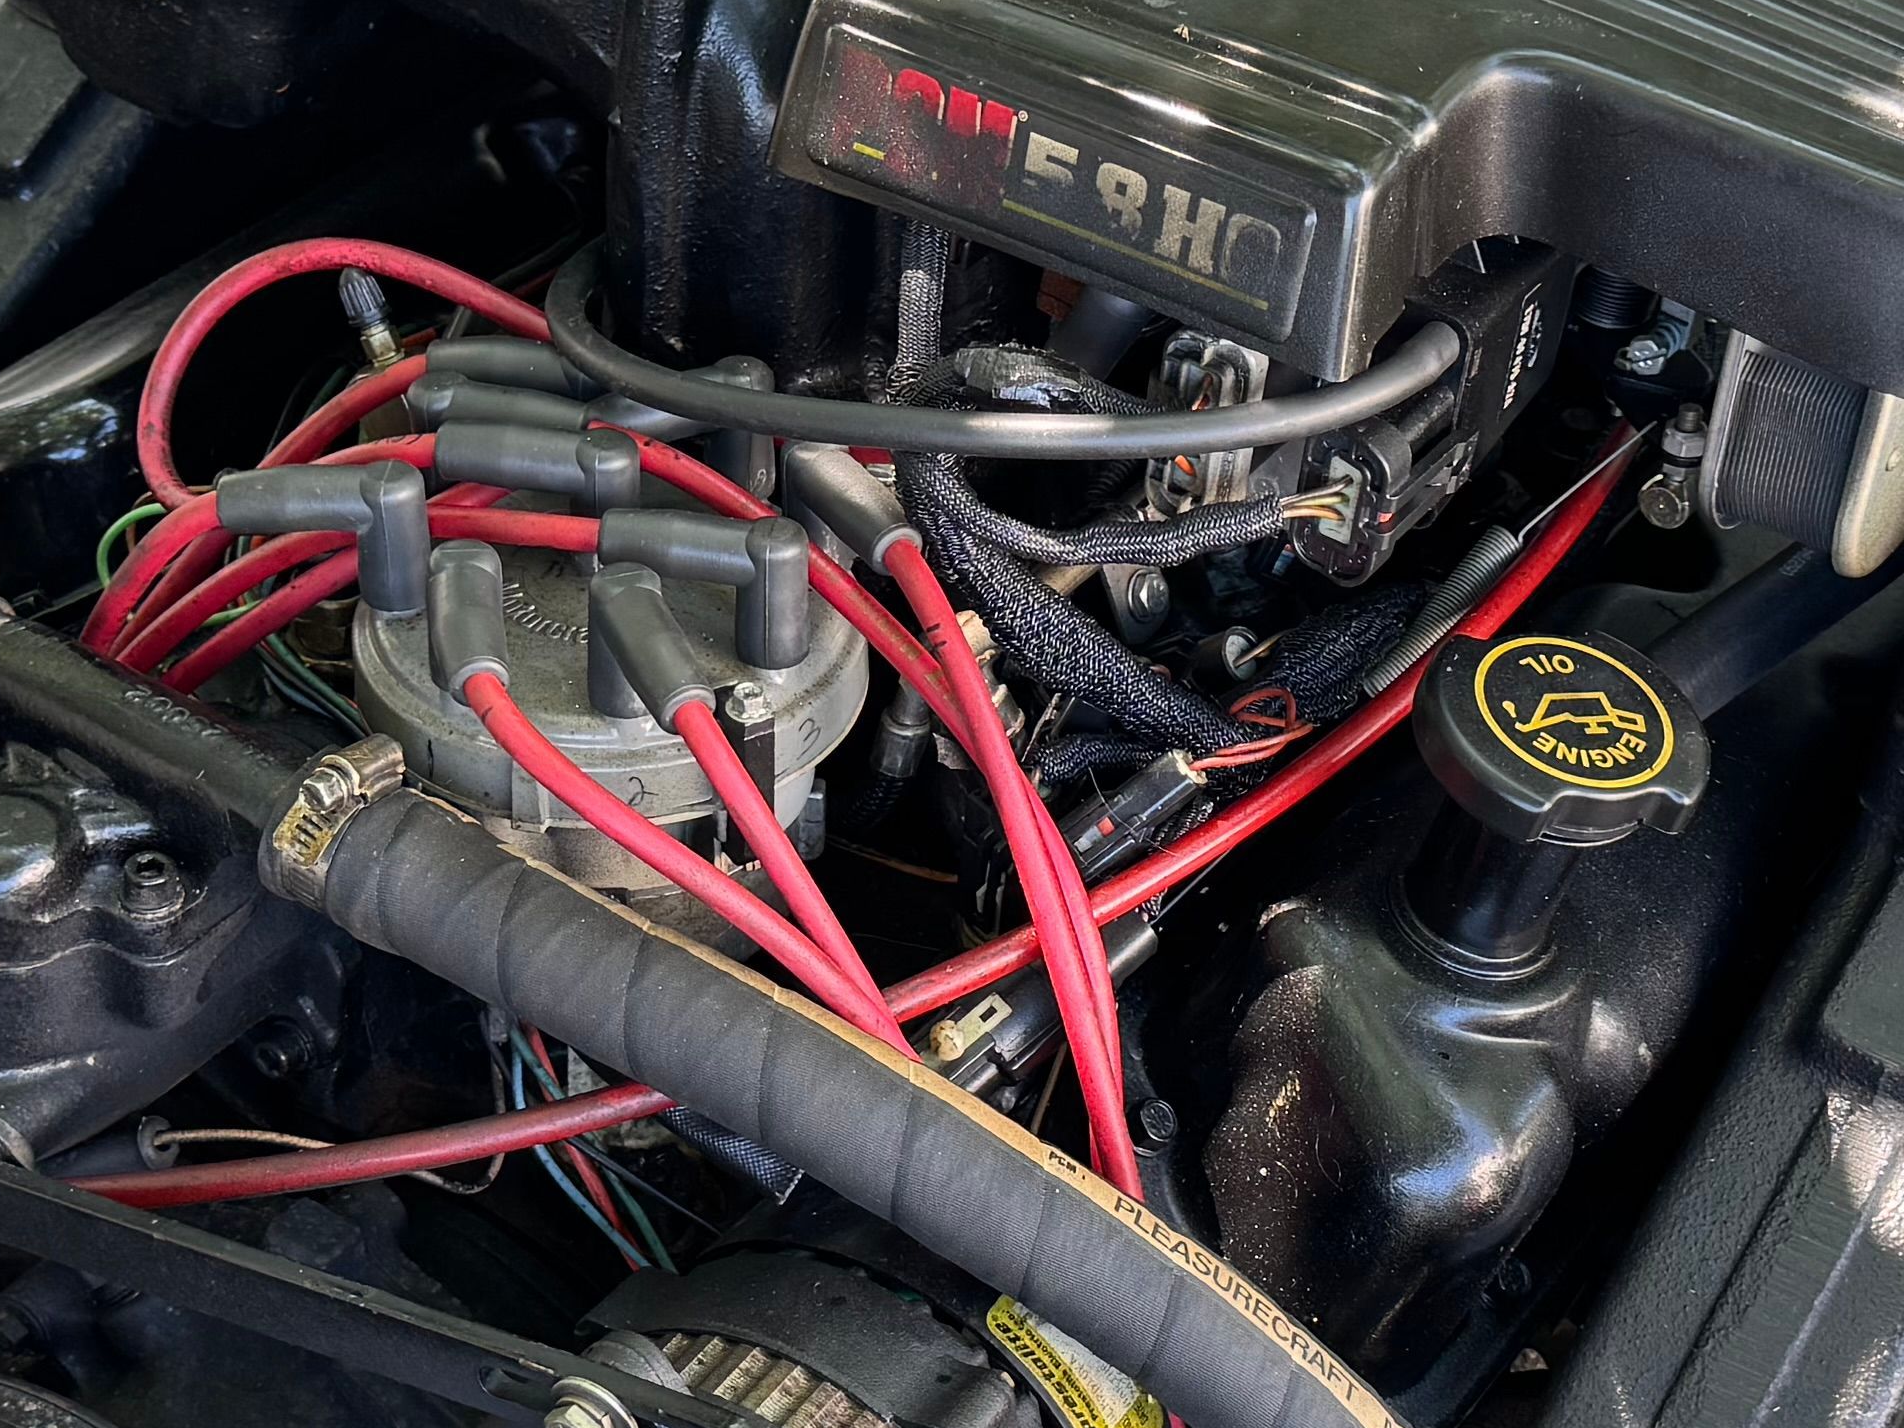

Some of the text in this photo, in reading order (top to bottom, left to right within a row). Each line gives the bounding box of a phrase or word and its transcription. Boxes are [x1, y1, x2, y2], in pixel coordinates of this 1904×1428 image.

[1519, 654, 1575, 675] OIL
[1532, 731, 1647, 768] ENGINE
[1113, 1195, 1361, 1401] PLEASURECRAFT
